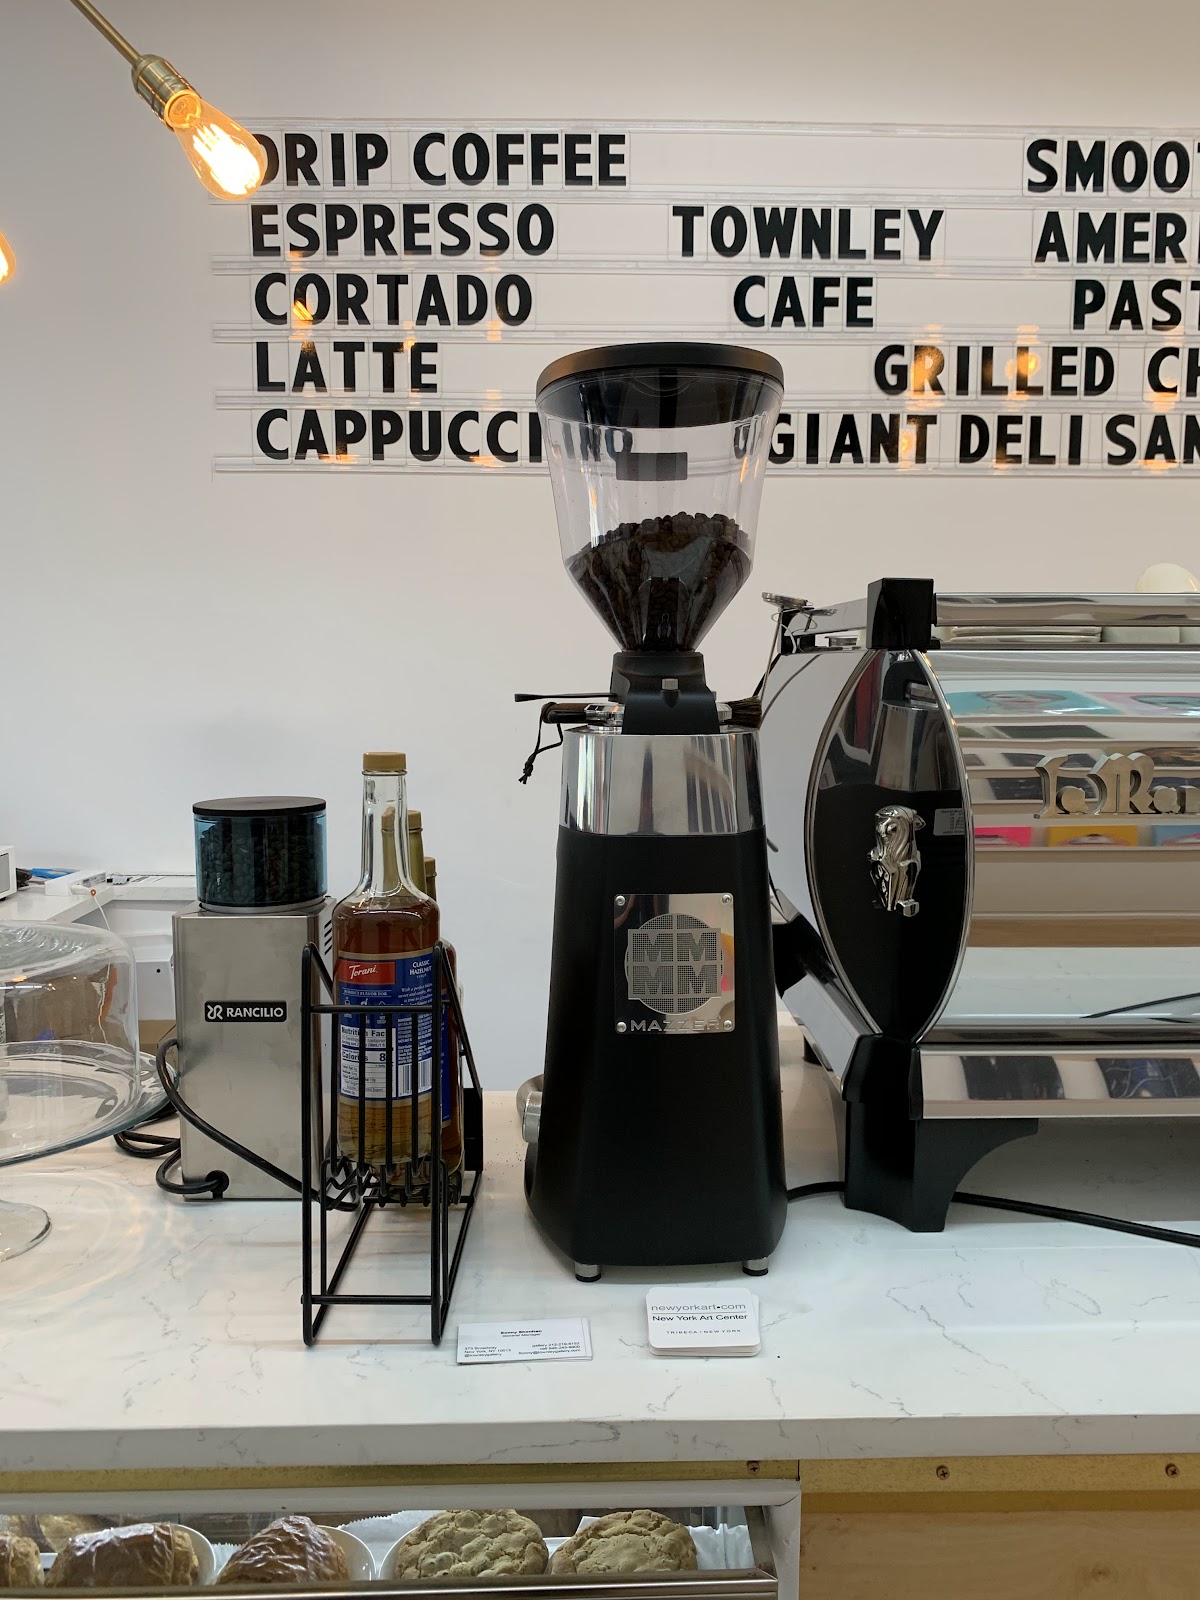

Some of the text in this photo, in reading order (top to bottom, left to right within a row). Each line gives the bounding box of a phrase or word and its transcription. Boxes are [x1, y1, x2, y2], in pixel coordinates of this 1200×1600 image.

[413, 133, 627, 187] COFFEE
[1027, 138, 1200, 193] SMOO
[251, 203, 555, 257] ESPRESSO
[672, 205, 944, 261] TOWNLEY
[1035, 211, 1200, 264] AMER
[255, 272, 532, 327] CORTADO
[733, 275, 874, 328] CAFE
[256, 341, 438, 393] LATTE
[874, 344, 1115, 397] GRILLED
[767, 412, 938, 465] GIANT
[959, 414, 1082, 466] DELI
[349, 964, 377, 979] Torani
[226, 1007, 284, 1018] RANCILIO
[630, 1019, 720, 1032] MAZZER
